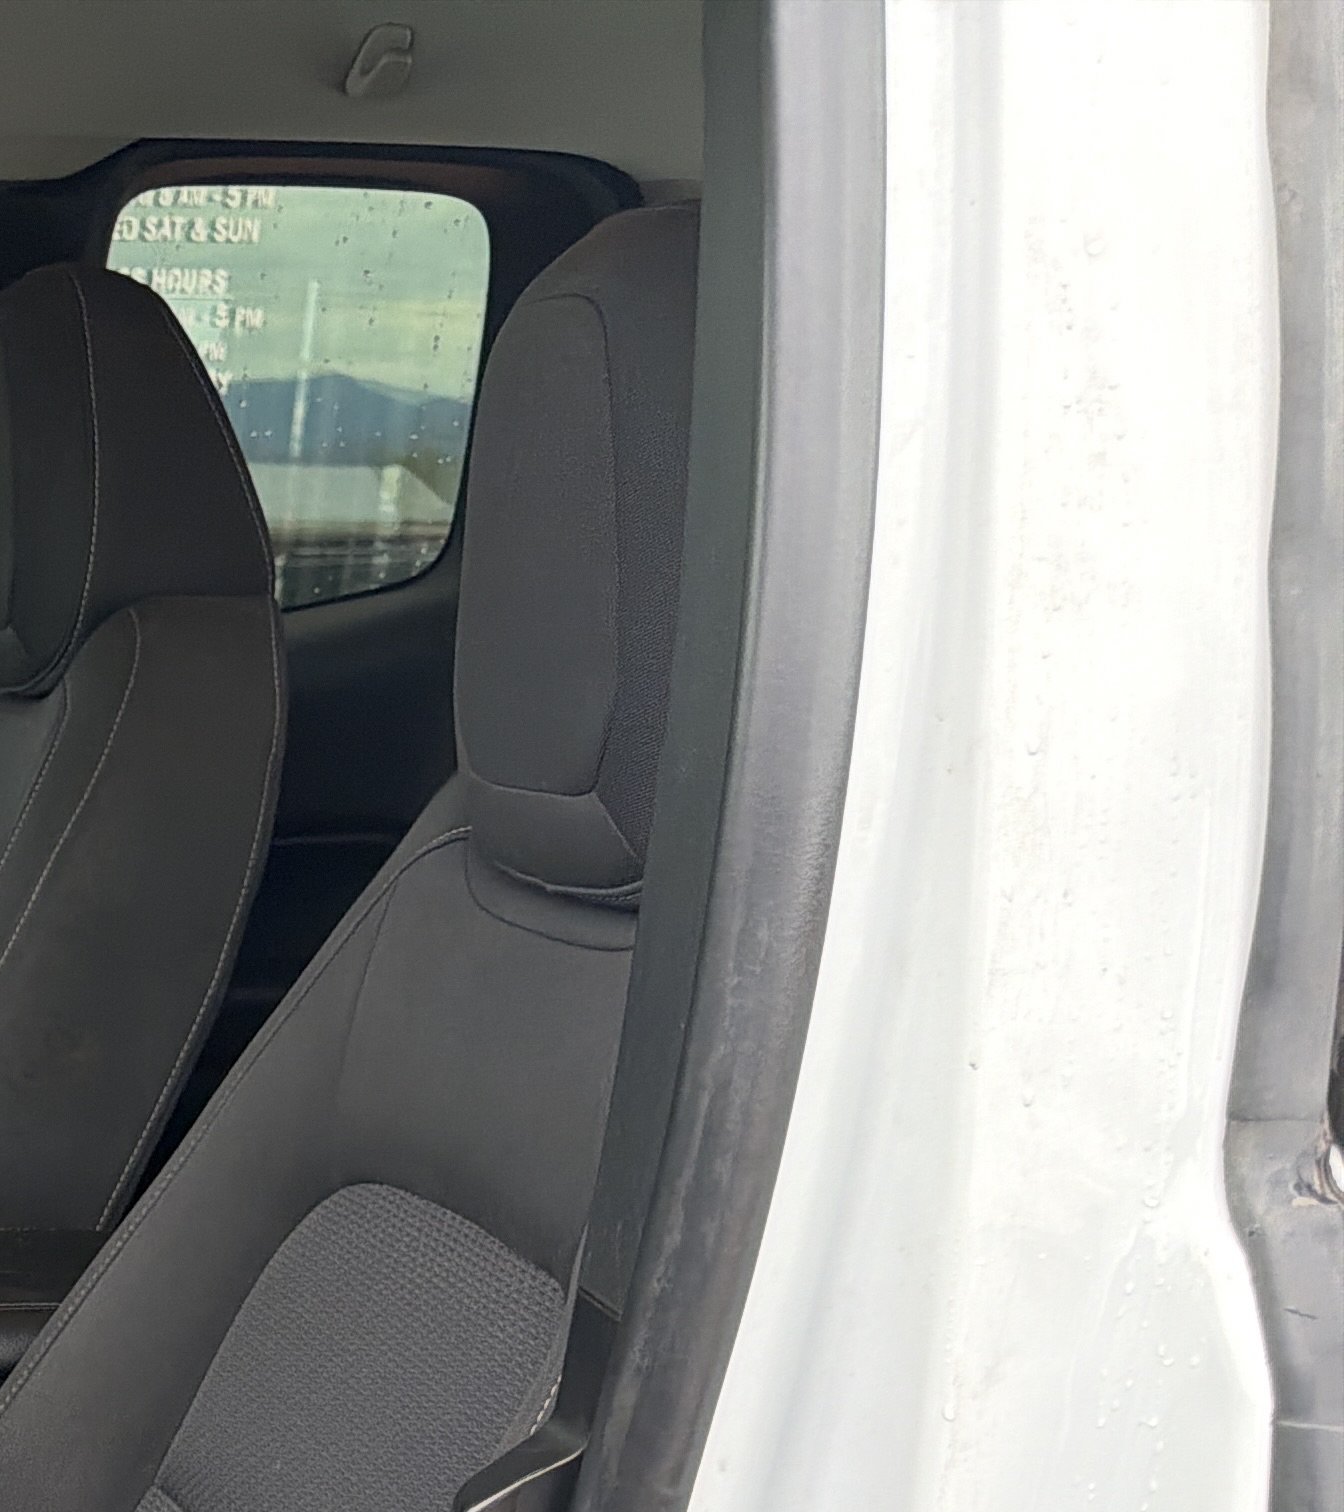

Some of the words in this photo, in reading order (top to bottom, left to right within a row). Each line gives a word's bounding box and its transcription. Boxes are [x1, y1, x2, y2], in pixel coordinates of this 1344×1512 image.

[143, 215, 187, 241] SAT
[191, 216, 208, 242] &
[213, 216, 262, 243] SUN
[151, 268, 229, 295] HOURS
